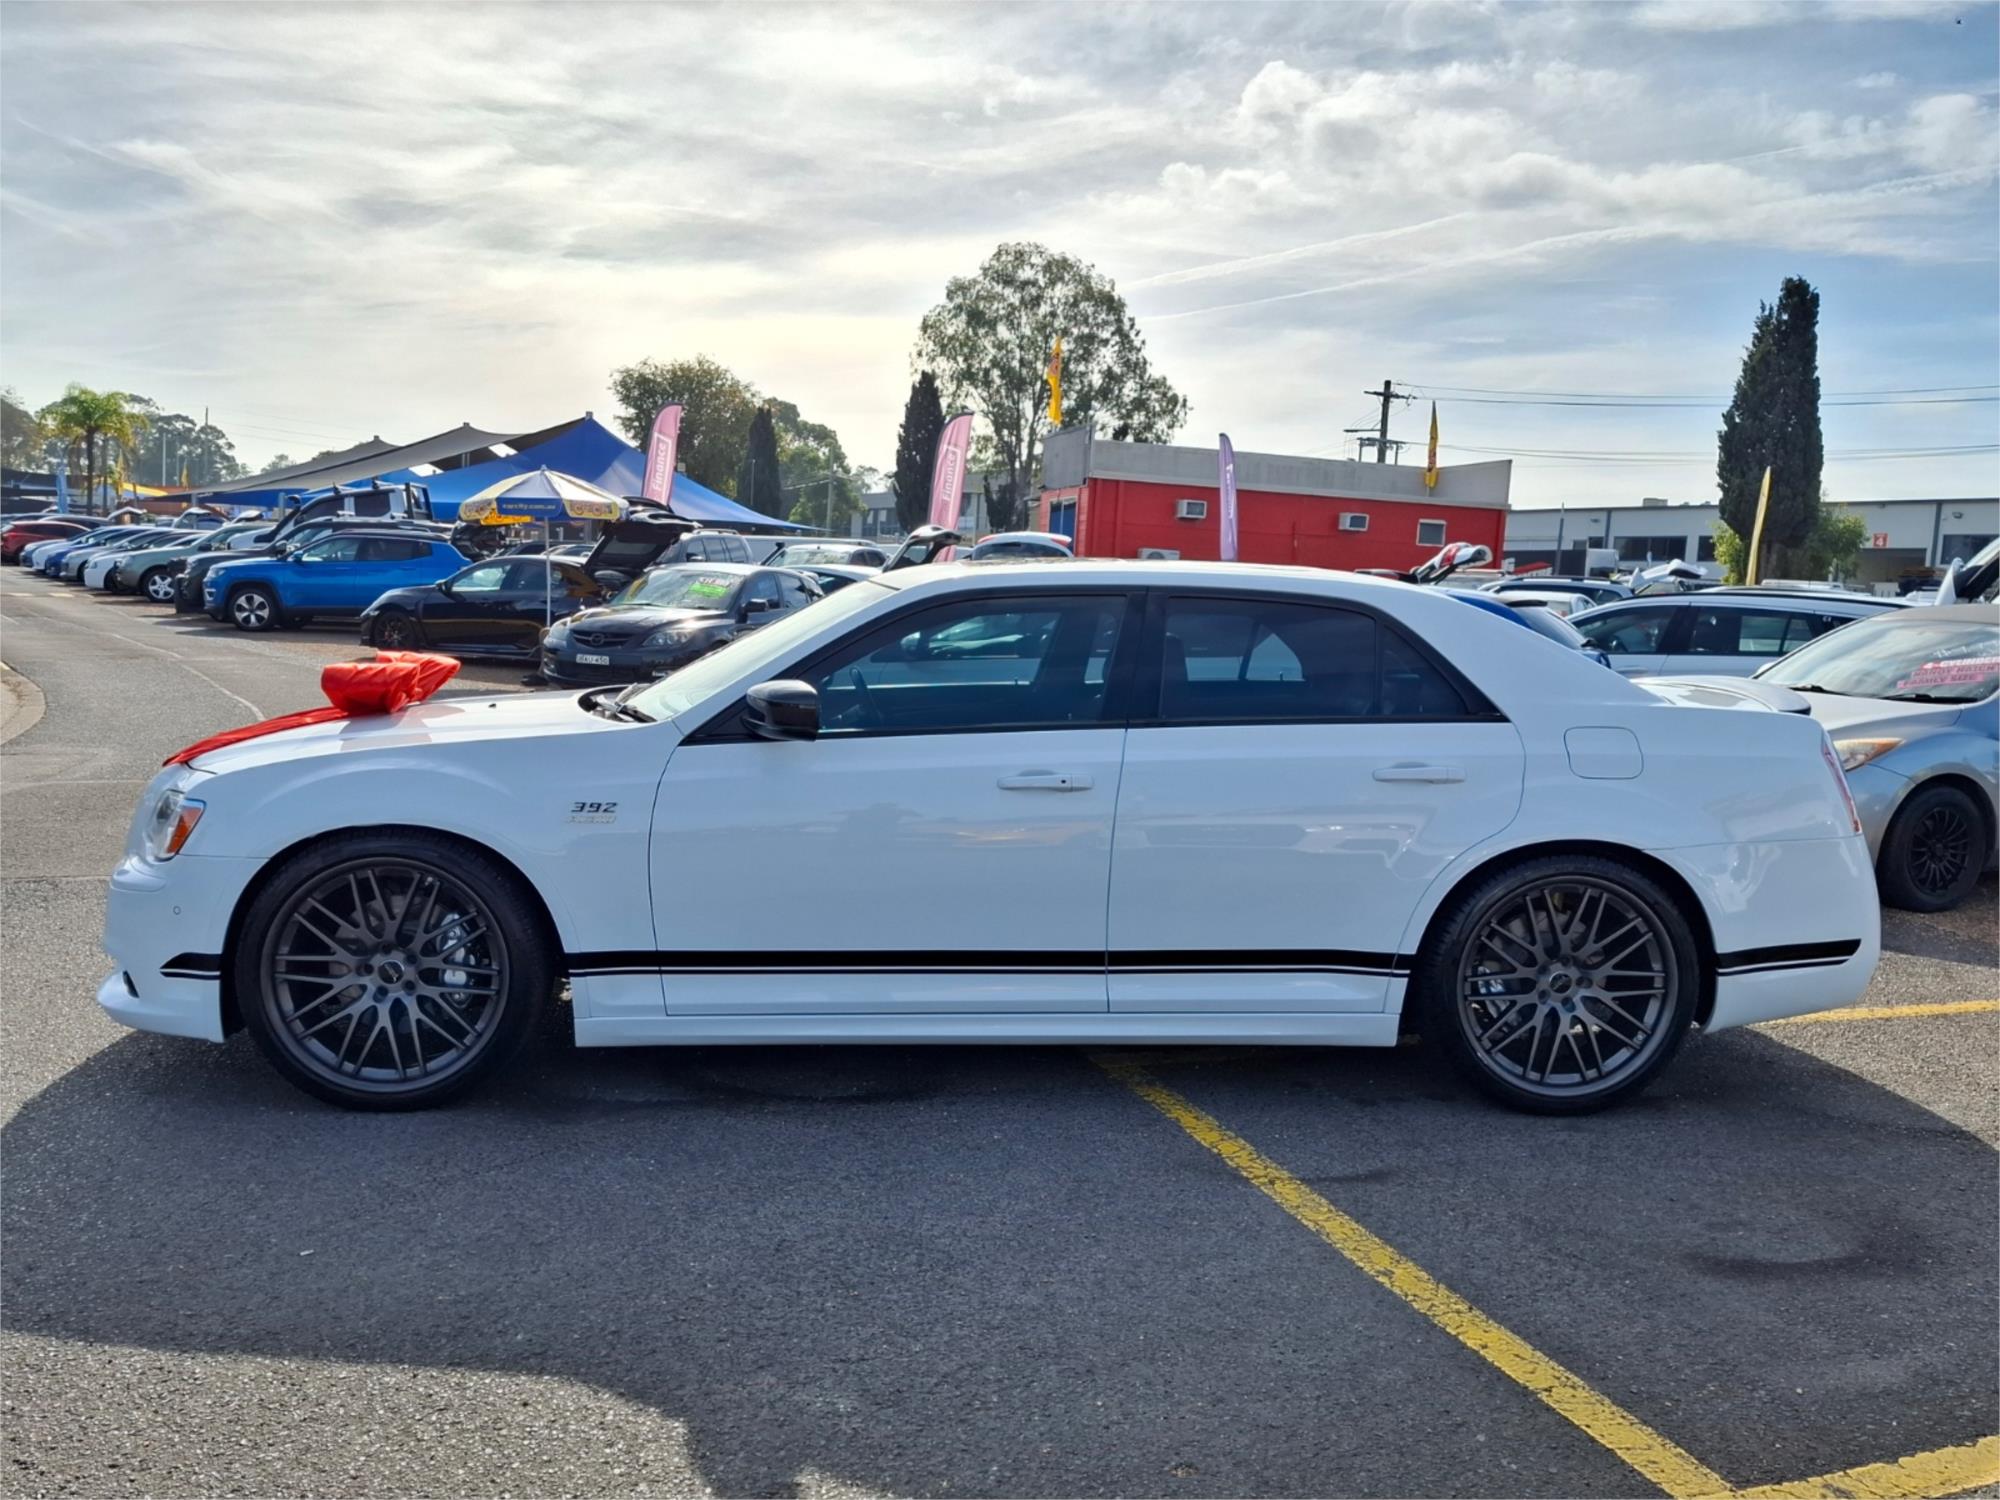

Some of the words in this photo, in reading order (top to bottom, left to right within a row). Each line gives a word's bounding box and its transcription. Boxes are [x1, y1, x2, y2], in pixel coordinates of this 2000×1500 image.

[653, 442, 667, 492] Finance
[943, 452, 956, 501] Finance
[571, 801, 617, 813] 392
